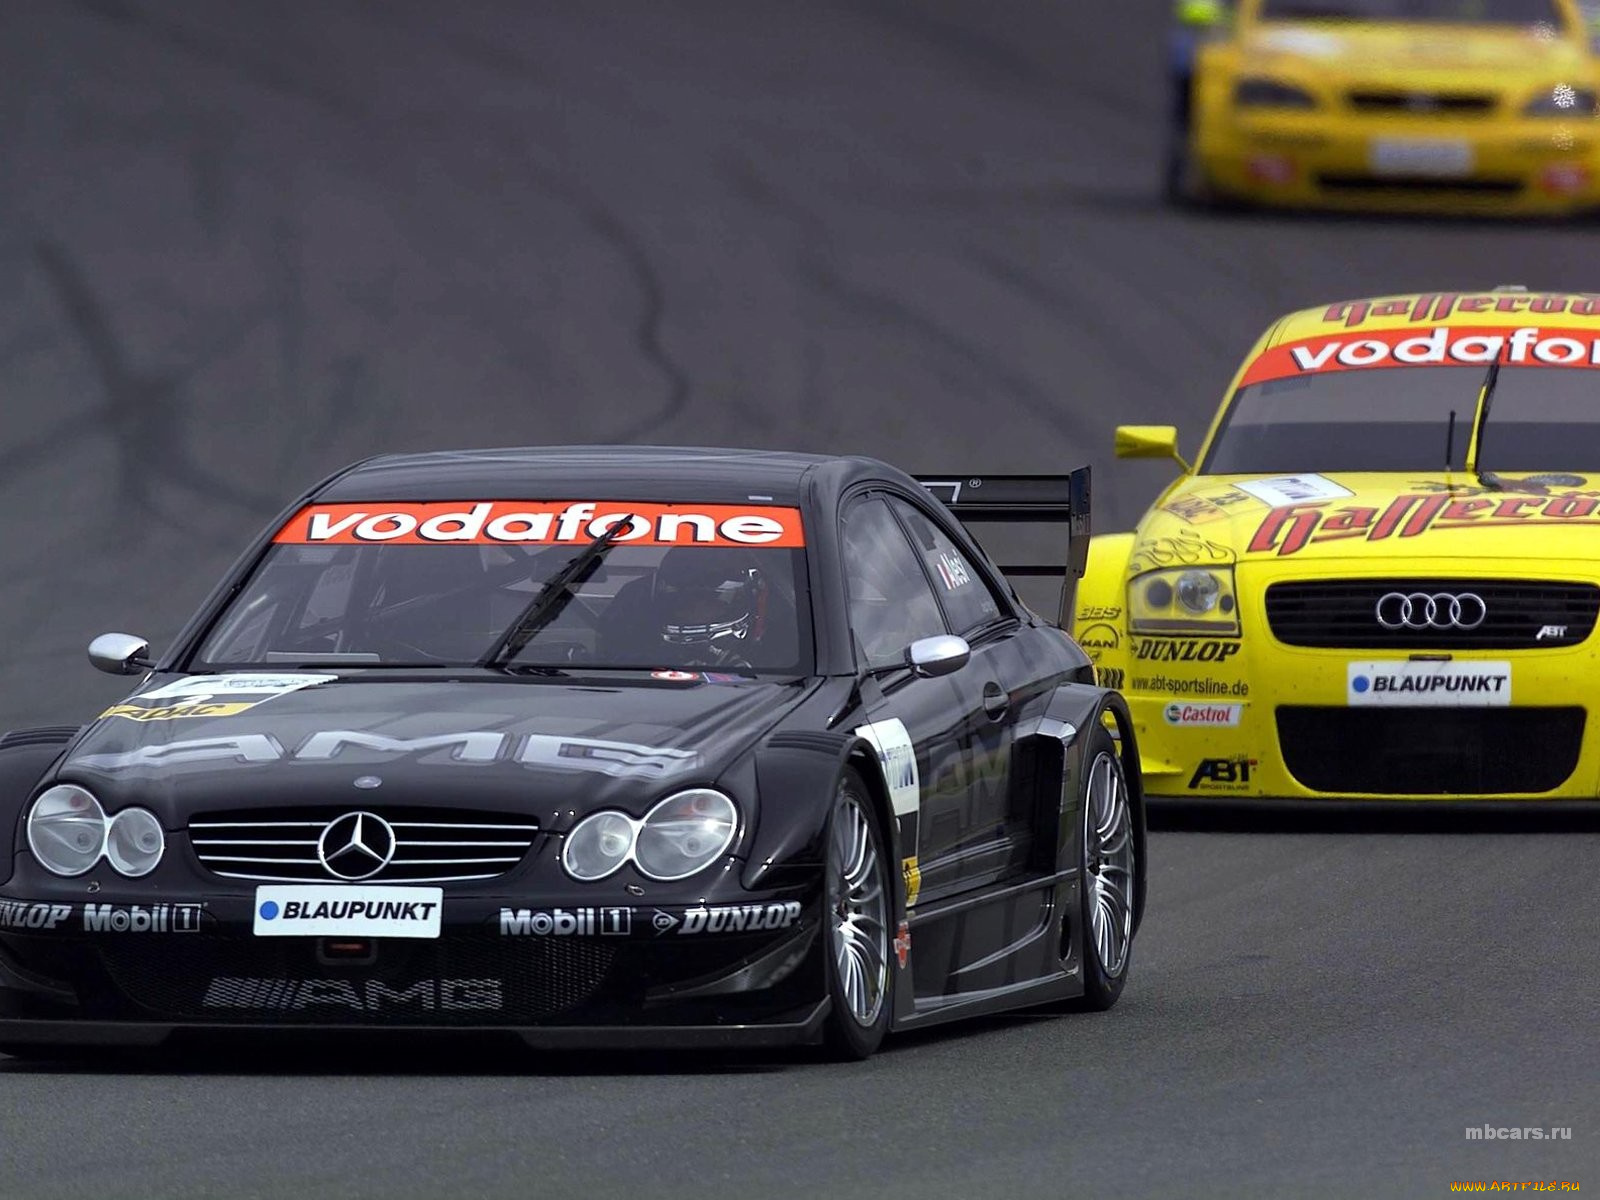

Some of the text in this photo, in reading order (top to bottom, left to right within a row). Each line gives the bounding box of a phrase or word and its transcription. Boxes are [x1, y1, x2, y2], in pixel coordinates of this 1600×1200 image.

[1292, 328, 1600, 371] vodafo
[306, 503, 785, 544] vodafone
[1081, 640, 1115, 648] MAN
[1536, 626, 1568, 640] ABT
[1137, 640, 1241, 662] DUNLOP
[1132, 675, 1249, 696] www.abt-sportsline.de
[1373, 675, 1507, 692] BLAUPUNKT
[1182, 705, 1231, 722] Castrol
[1188, 757, 1250, 789] ABT
[0, 901, 73, 929] NLOP
[83, 903, 169, 932] Mobil
[282, 901, 437, 920] BLAUPUNKT
[500, 907, 595, 936] Mobil
[676, 901, 801, 935] DUNLOP
